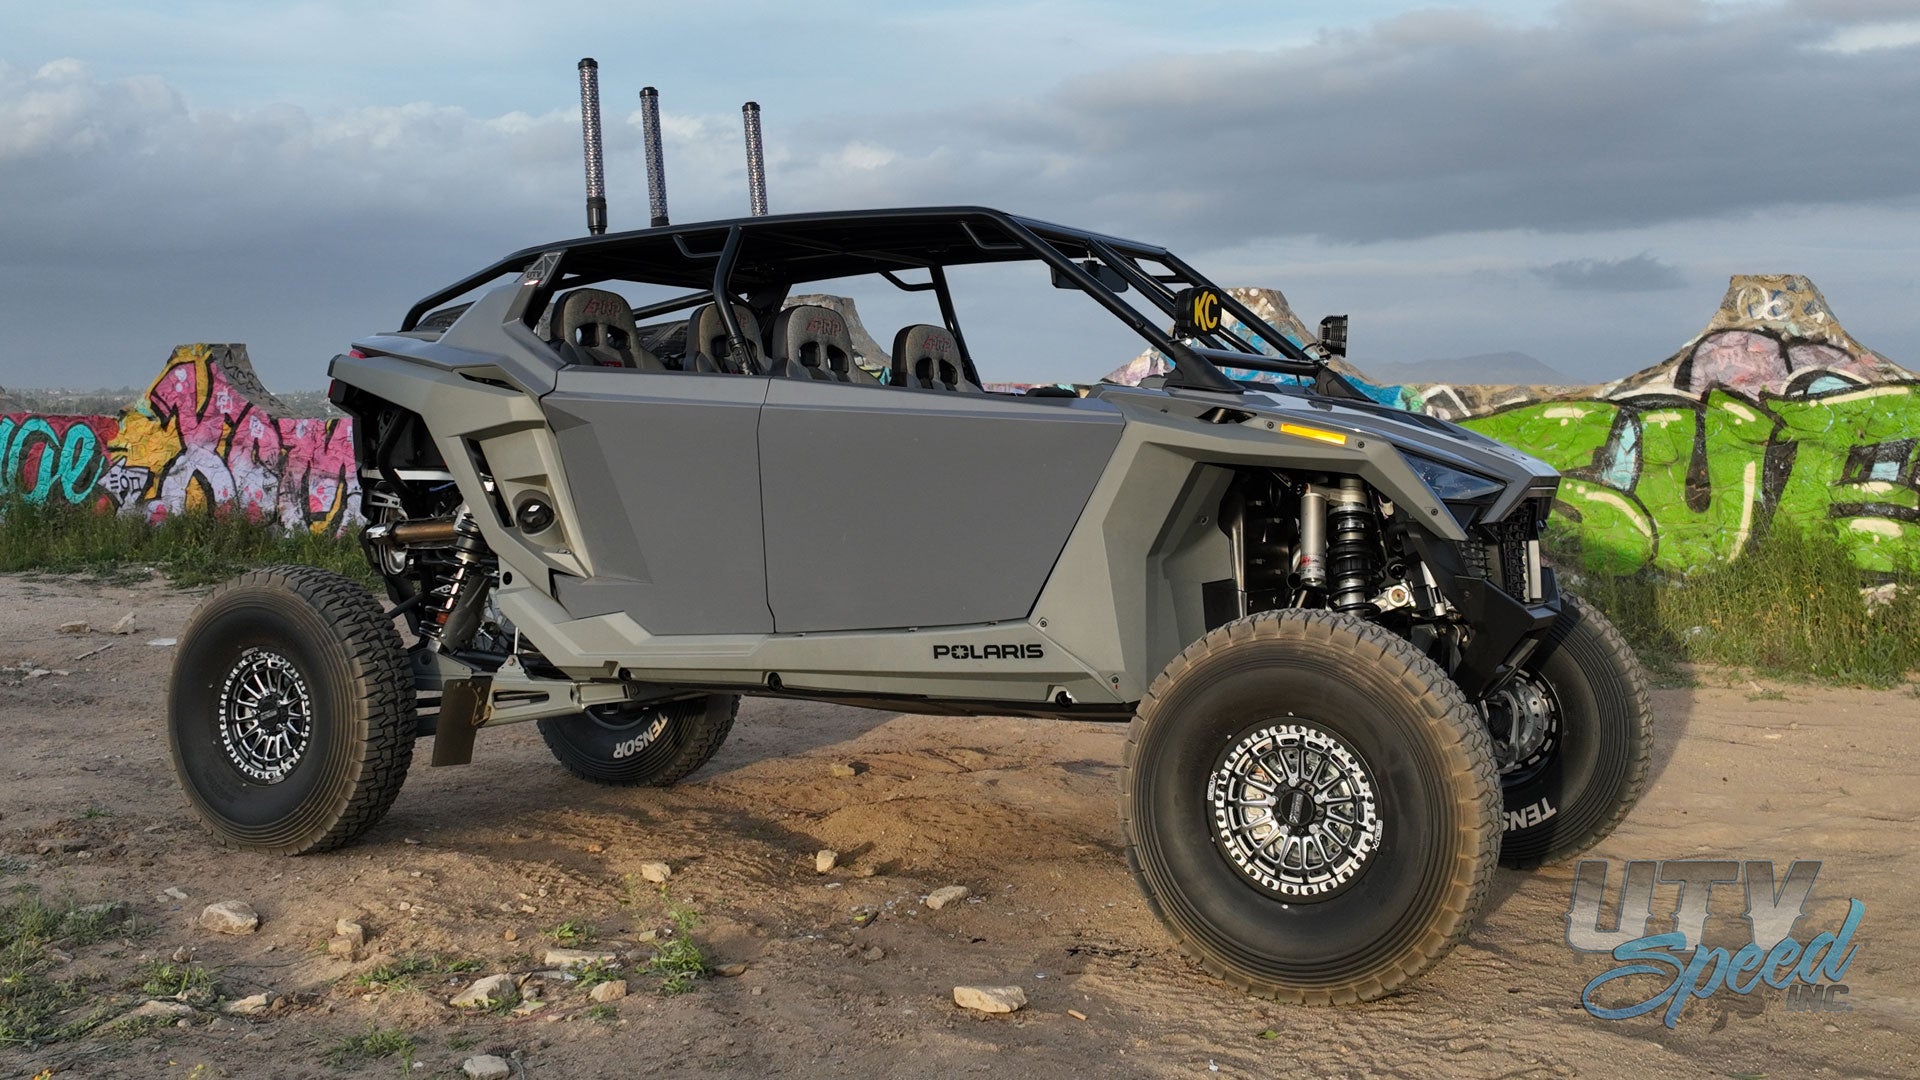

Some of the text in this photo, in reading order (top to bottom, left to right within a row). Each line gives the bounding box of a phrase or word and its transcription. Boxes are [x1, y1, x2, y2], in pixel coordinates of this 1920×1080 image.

[1194, 291, 1218, 332] KC
[933, 644, 1044, 660] POLARIS
[613, 711, 669, 759] TENSOR
